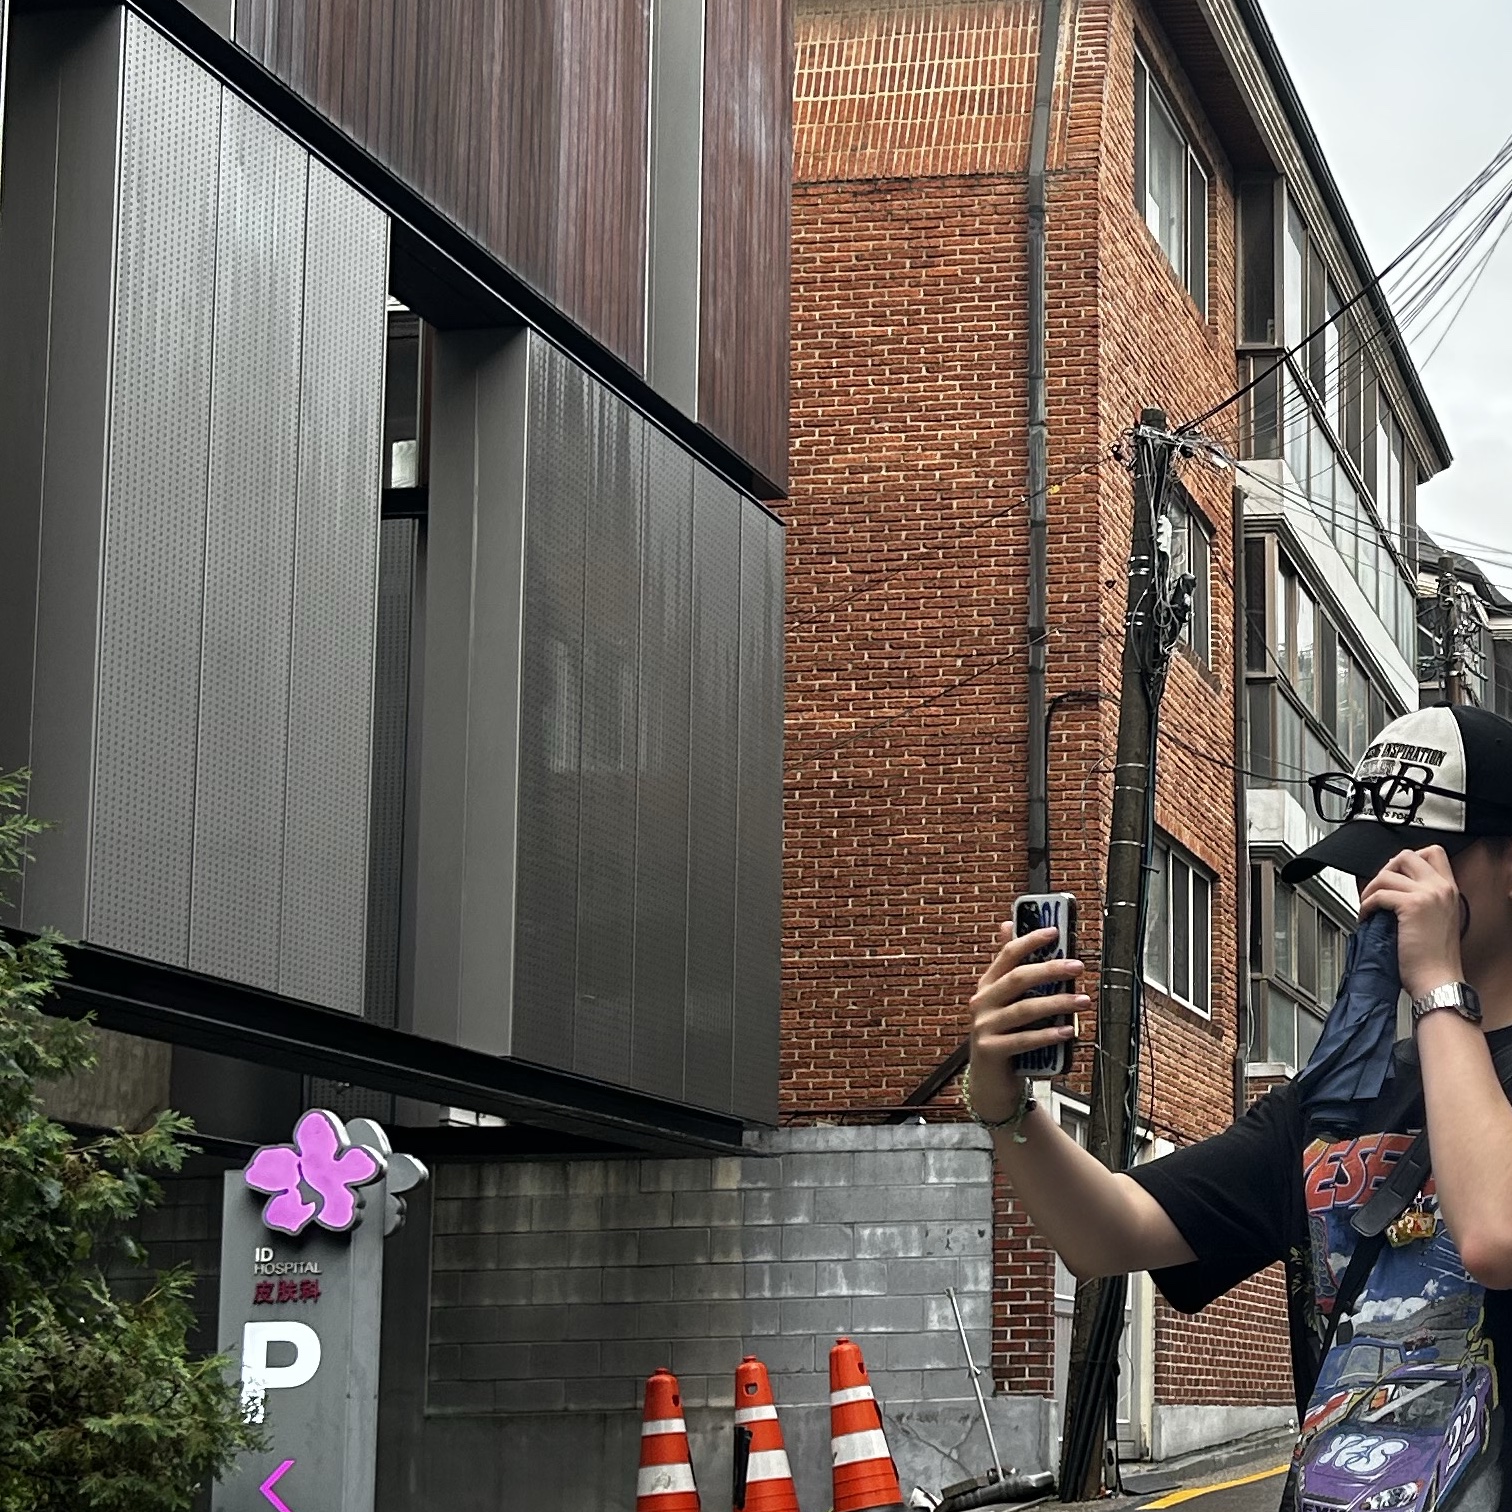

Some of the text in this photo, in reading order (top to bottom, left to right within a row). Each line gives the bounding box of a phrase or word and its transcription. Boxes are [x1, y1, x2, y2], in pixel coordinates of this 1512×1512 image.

[254, 1261, 322, 1275] HOSPITAL
[255, 1247, 274, 1262] ID
[241, 1321, 321, 1424] P
[1318, 1434, 1409, 1475] YES
